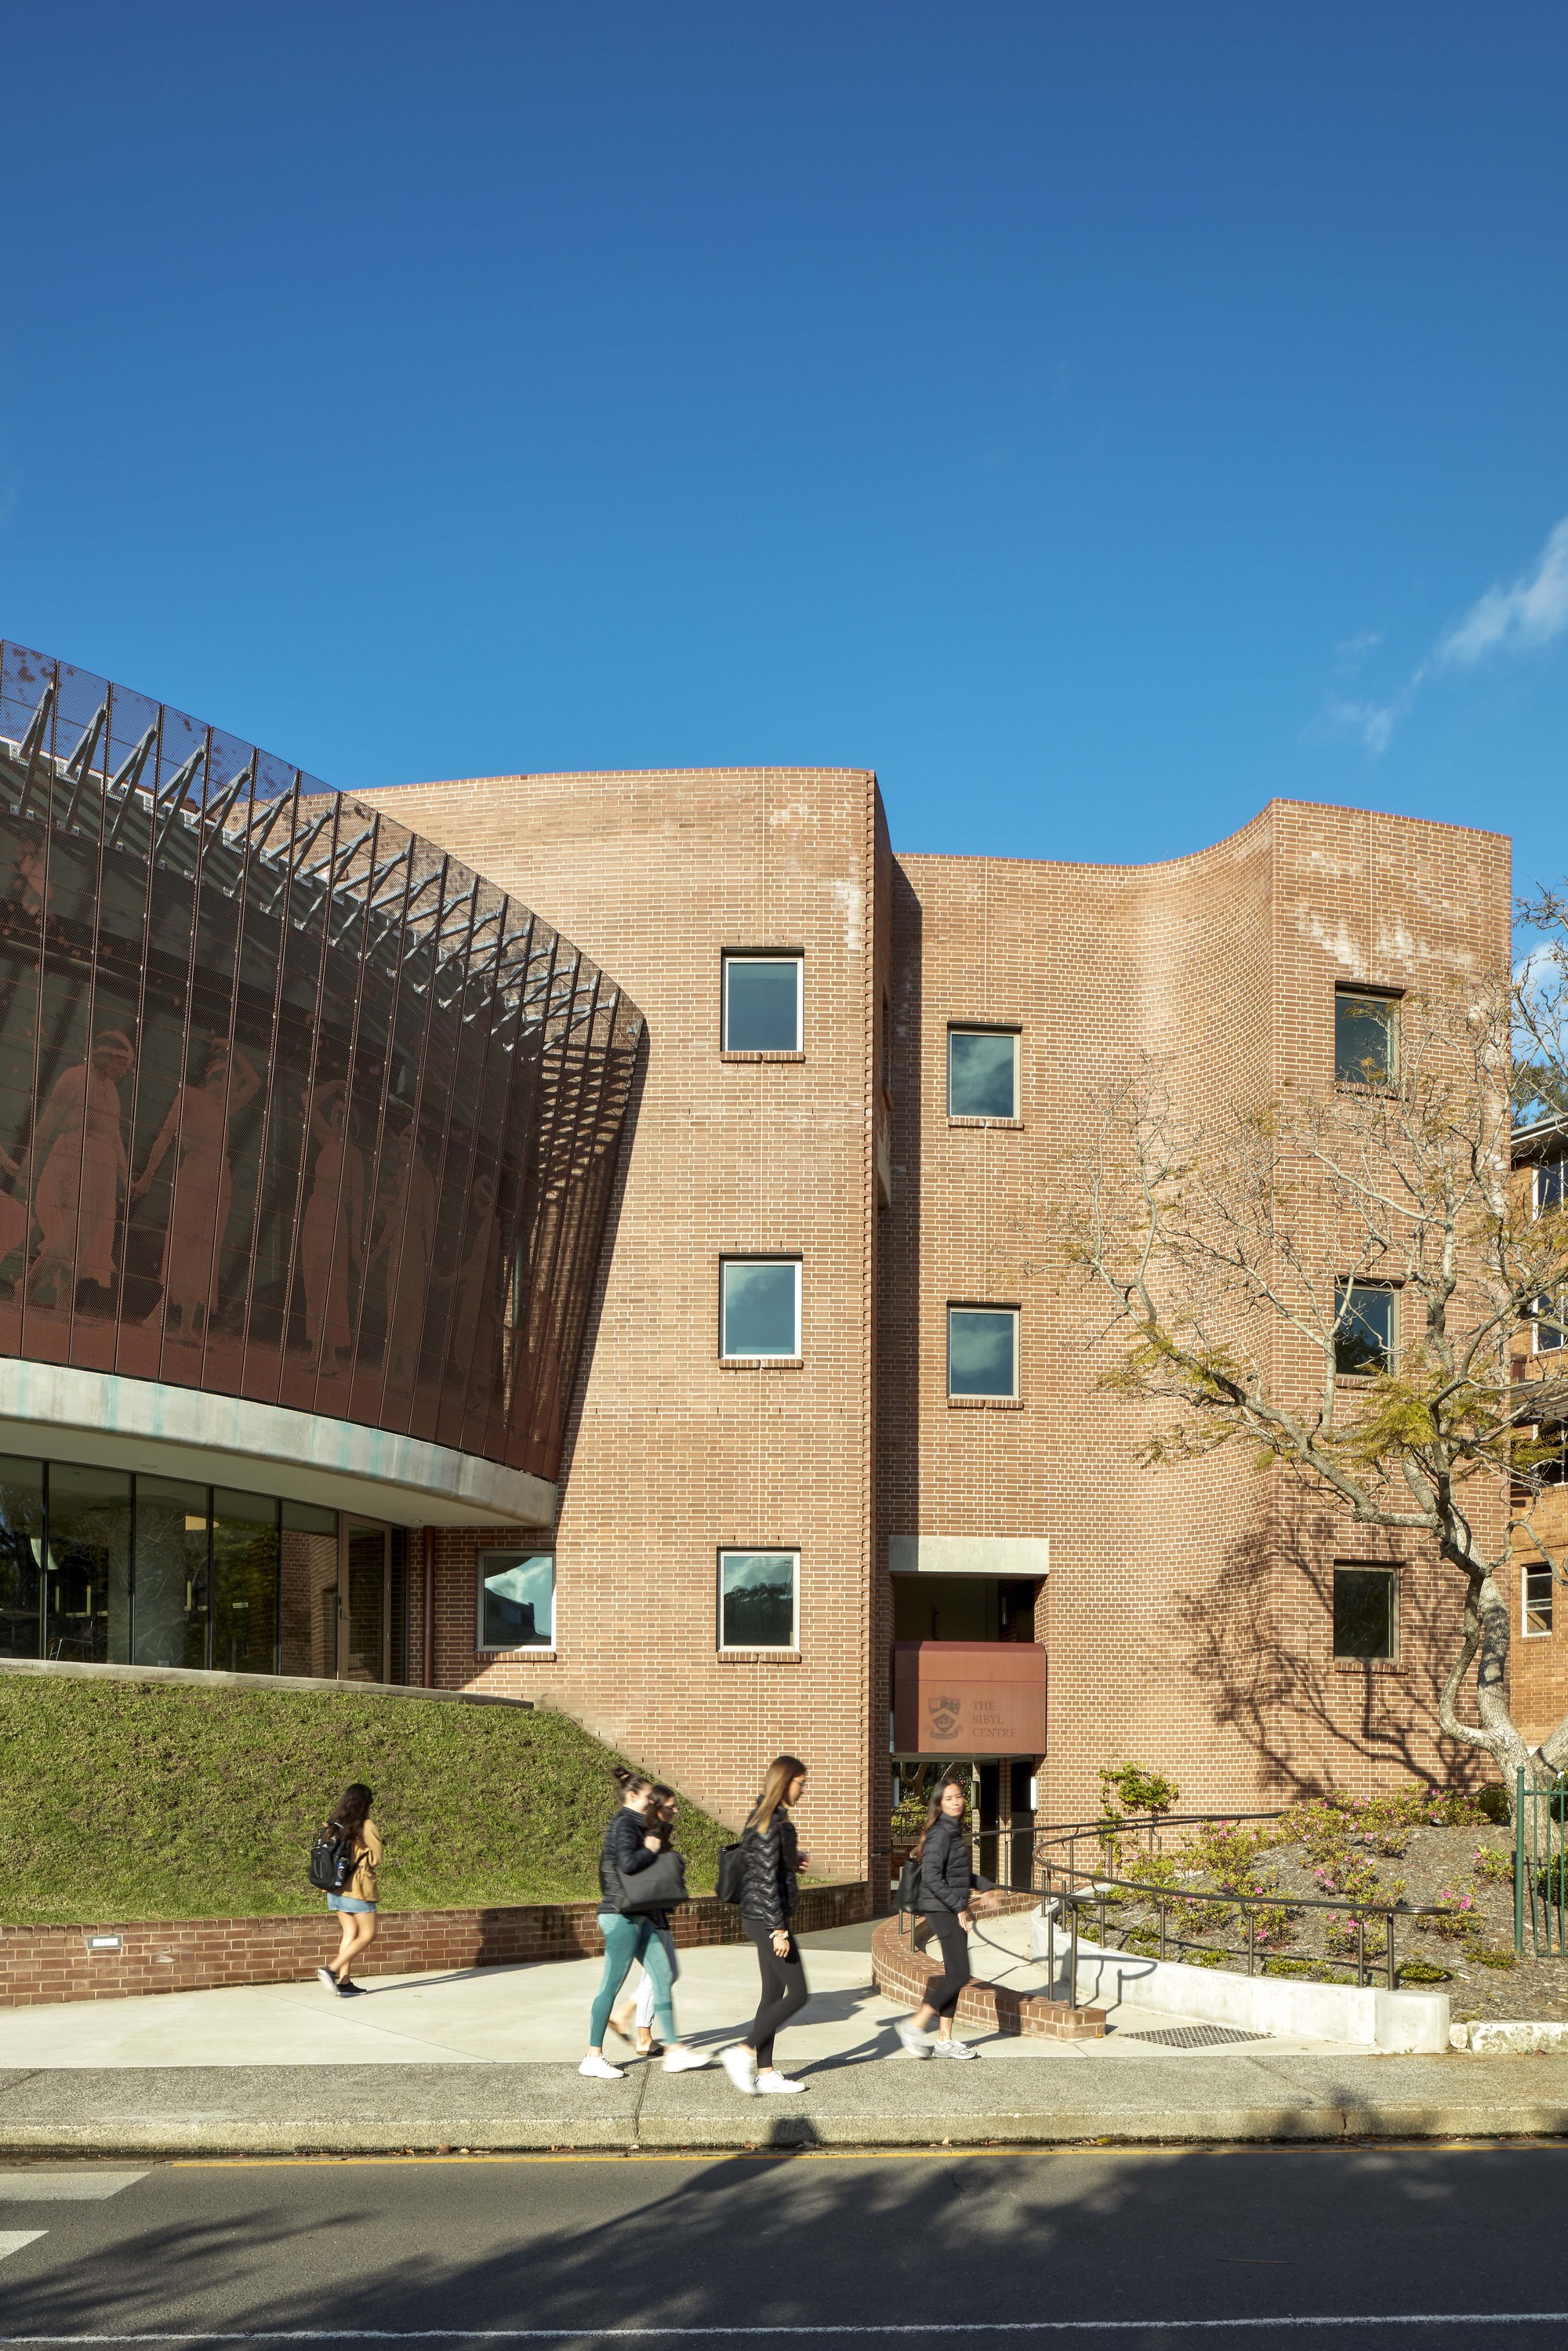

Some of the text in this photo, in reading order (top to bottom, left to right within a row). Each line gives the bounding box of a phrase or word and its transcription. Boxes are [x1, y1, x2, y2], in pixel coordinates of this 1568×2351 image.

[972, 1700, 996, 1711] THE
[972, 1714, 1004, 1725] SIBYL
[972, 1728, 1017, 1737] CENTRE
